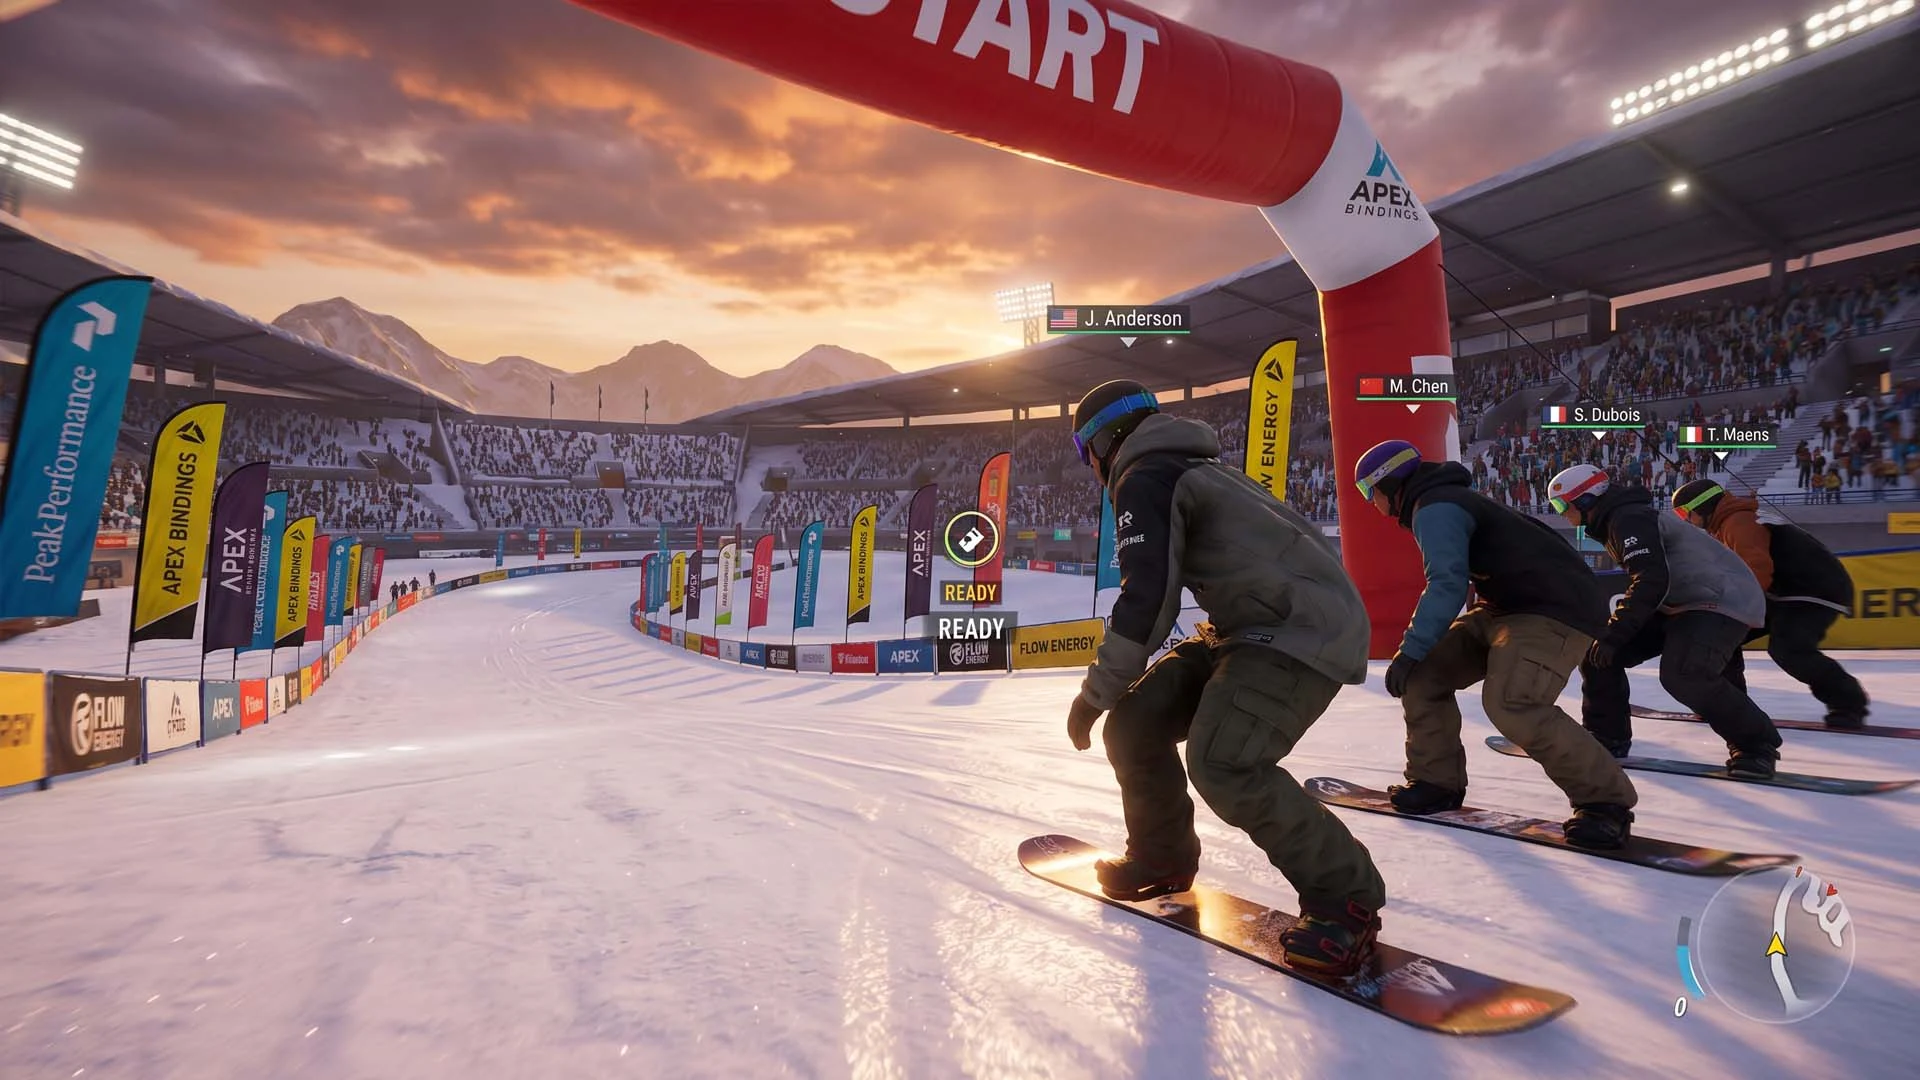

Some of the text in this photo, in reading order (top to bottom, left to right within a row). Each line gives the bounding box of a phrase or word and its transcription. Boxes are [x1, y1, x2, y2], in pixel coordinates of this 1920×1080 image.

[1349, 180, 1415, 208] APEX
[1345, 204, 1419, 221] BINDINGS
[1262, 390, 1279, 467] ENERGY
[23, 365, 97, 583] PeakPerformance
[162, 452, 197, 595] APEX BINDINGS
[220, 527, 247, 593] APEX
[912, 530, 926, 576] APEX
[857, 576, 865, 600] APEX
[288, 595, 299, 622] APEX
[890, 651, 919, 663] APEX
[965, 641, 989, 655] FLOW
[1020, 637, 1095, 655] FLOW ENERGY
[94, 696, 125, 729] FLOW
[212, 697, 234, 721] APEX
